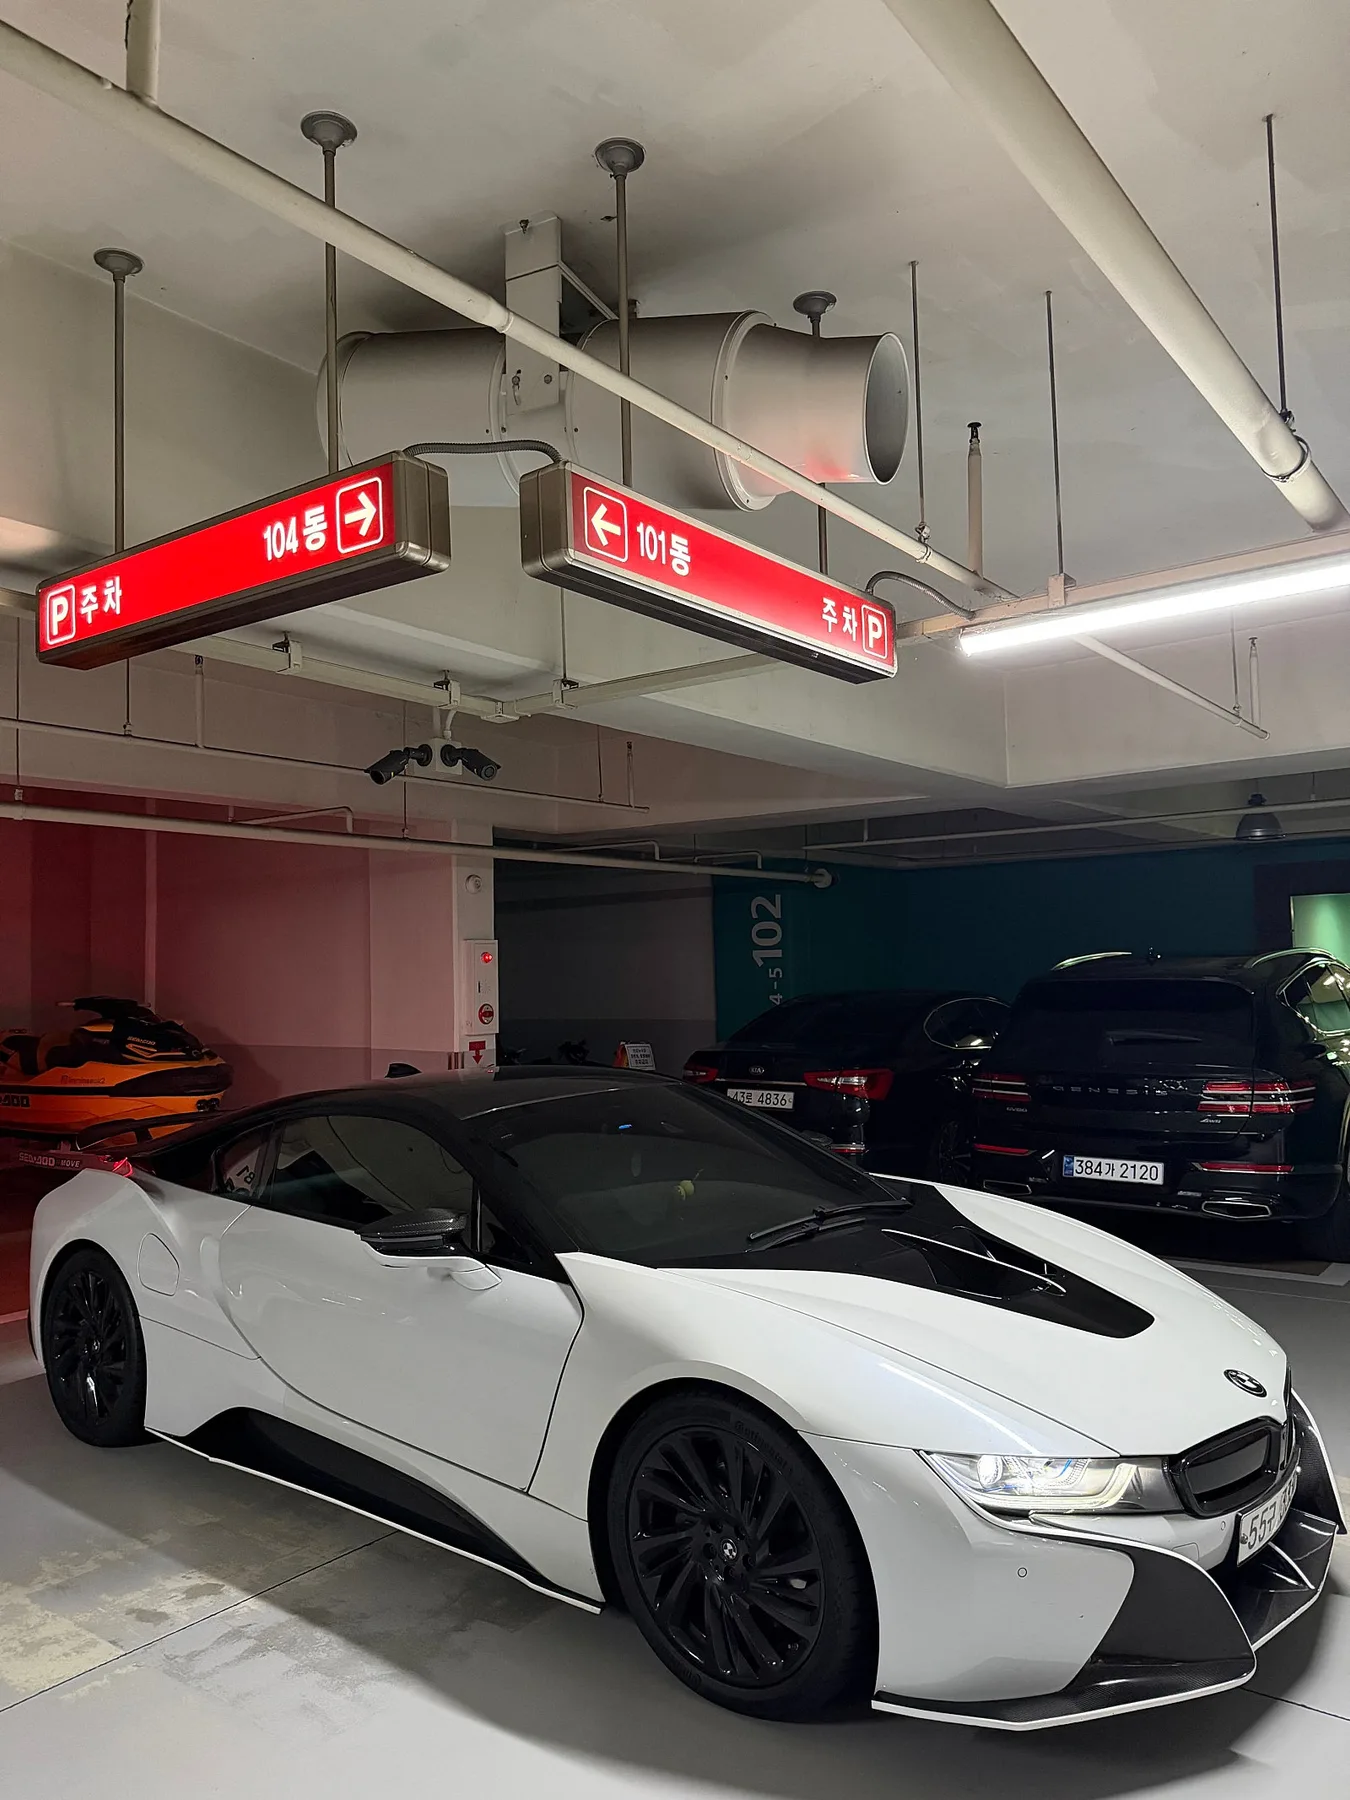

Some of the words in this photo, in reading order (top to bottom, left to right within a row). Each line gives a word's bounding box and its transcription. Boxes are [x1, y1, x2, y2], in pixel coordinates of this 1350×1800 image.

[263, 505, 328, 562] 104동
[636, 521, 691, 577] 101동
[52, 596, 69, 636] P
[80, 576, 122, 624] 주차
[821, 597, 858, 642] 주차
[867, 614, 883, 649] P
[750, 894, 783, 968] 102
[757, 1092, 787, 1107] 4836
[1052, 1085, 1168, 1098] GENESIS
[61, 1159, 81, 1168] MOVE
[1075, 1159, 1115, 1177] 384가
[1119, 1162, 1159, 1181] 2120
